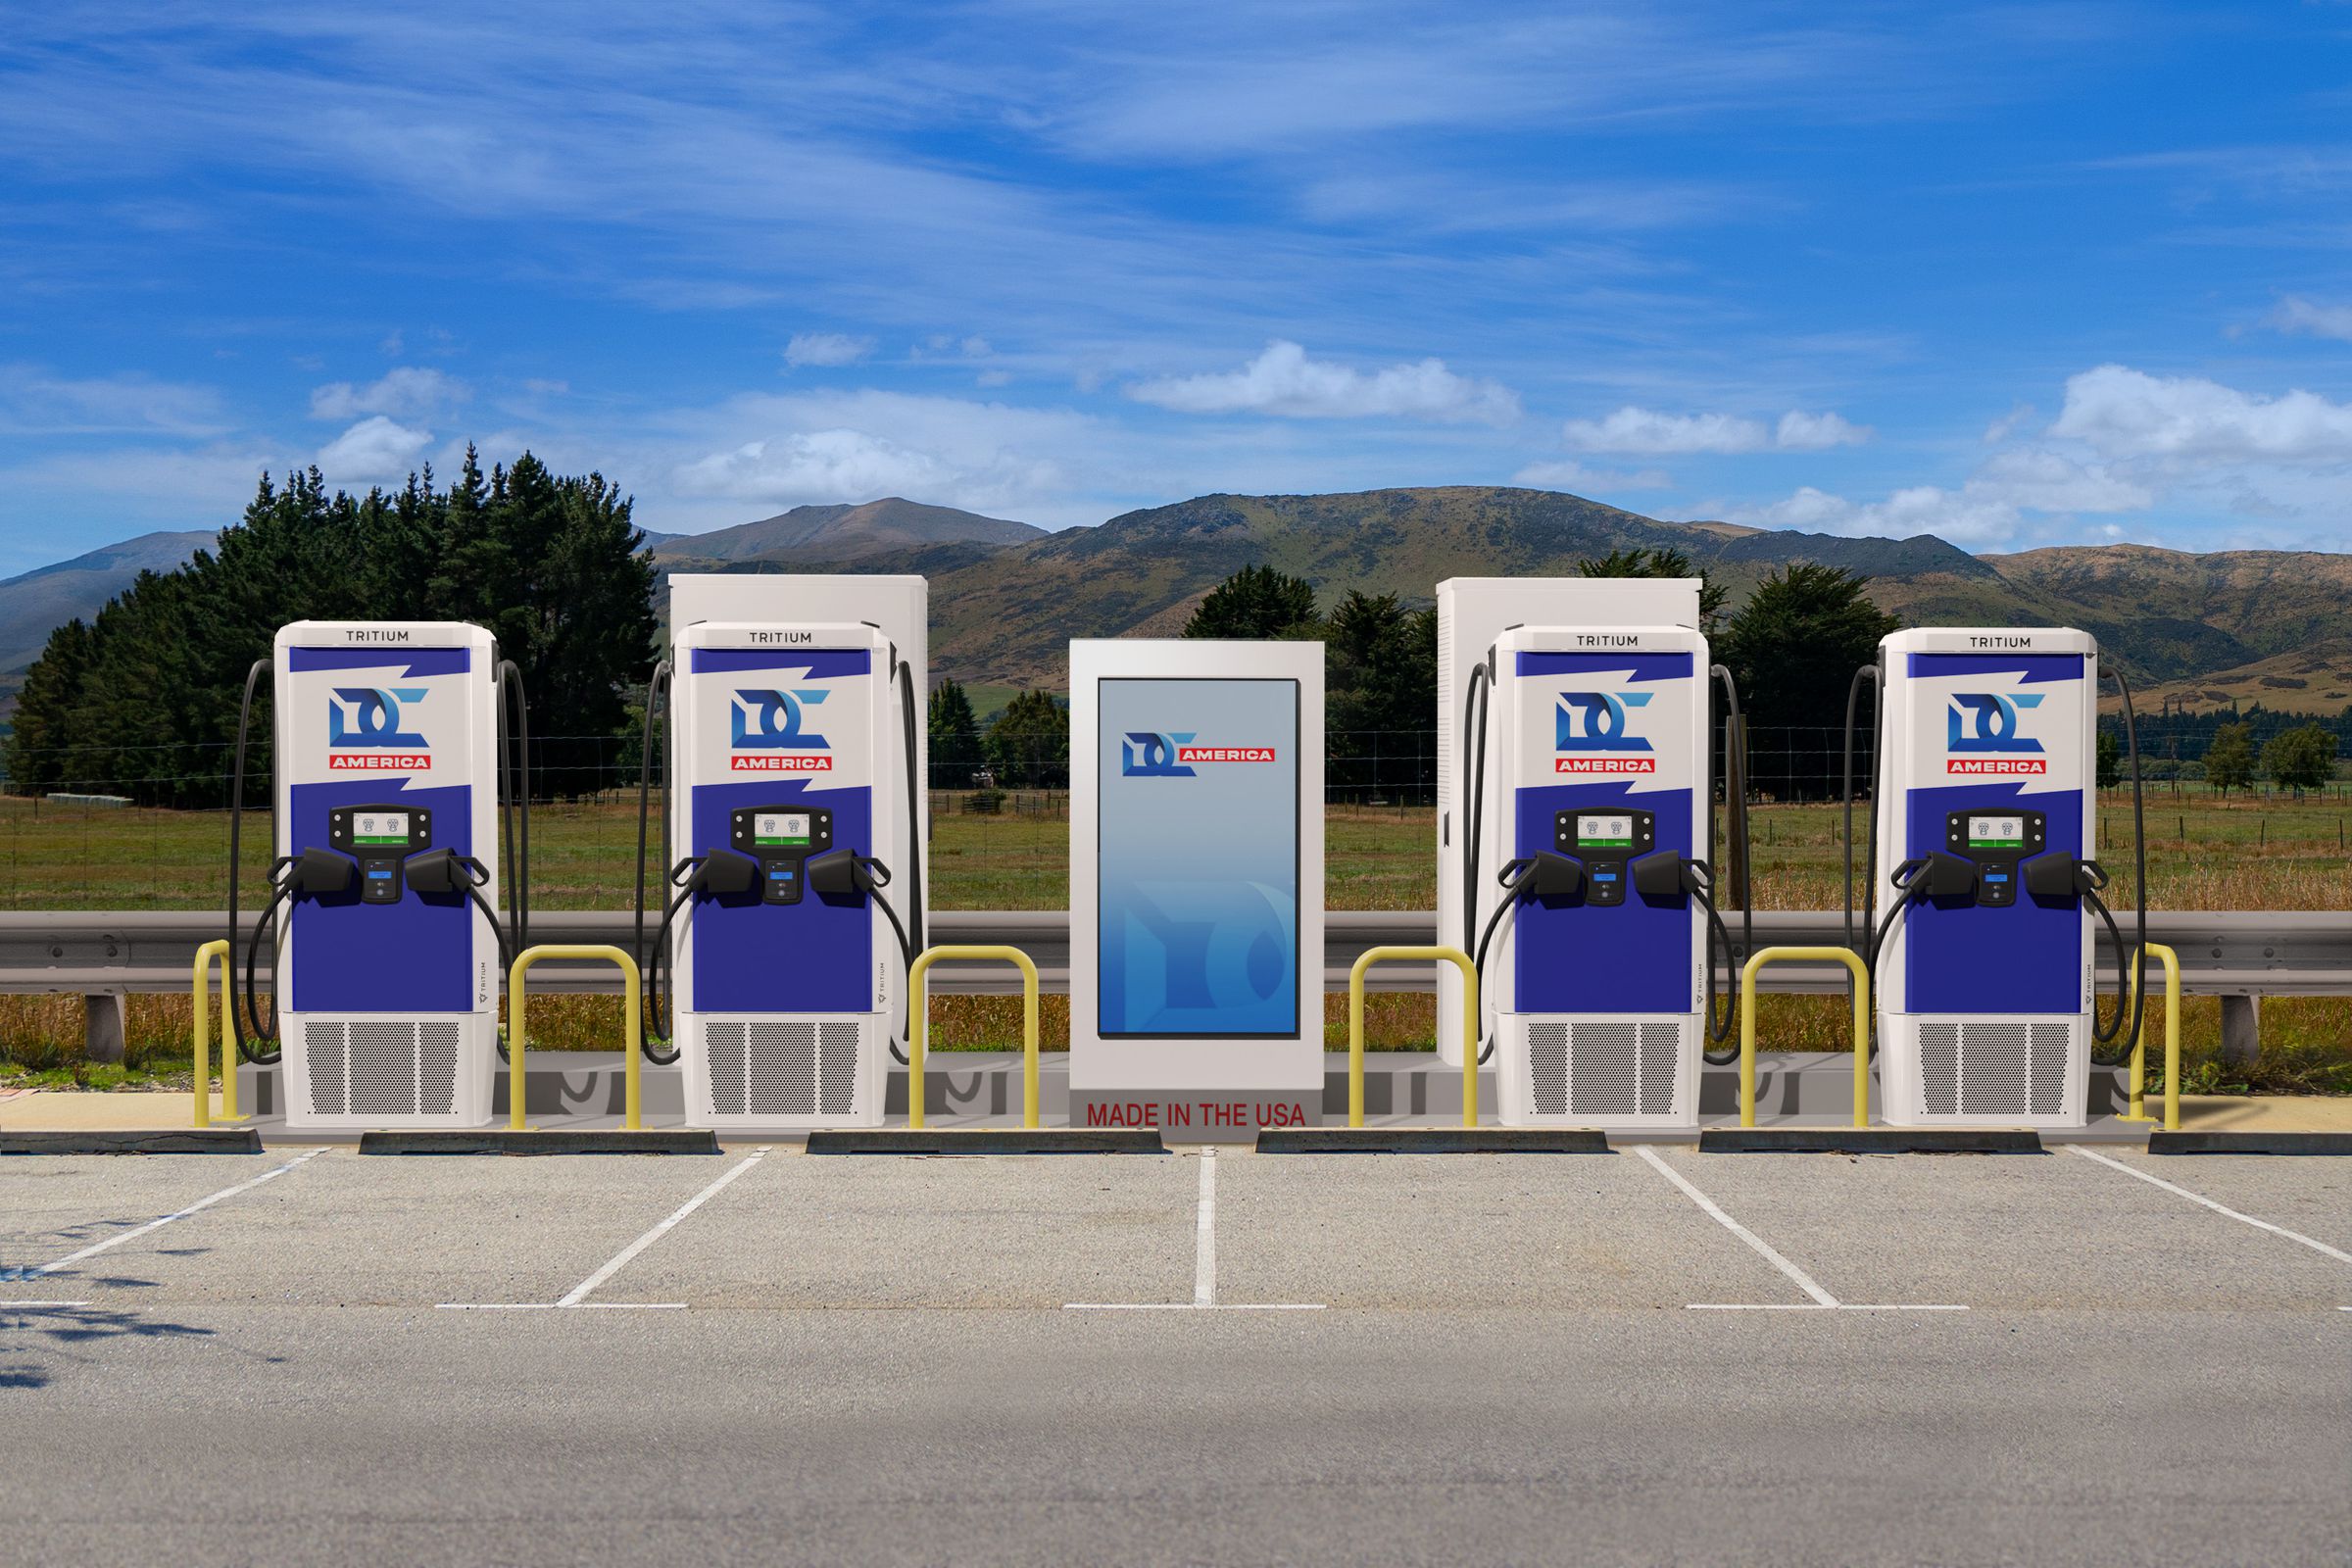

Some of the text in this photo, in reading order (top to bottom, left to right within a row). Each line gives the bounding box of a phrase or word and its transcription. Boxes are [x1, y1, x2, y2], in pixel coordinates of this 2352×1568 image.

[346, 630, 409, 641] TRITIUM
[750, 632, 811, 643] TRITIUM
[1577, 635, 1639, 646] TRITIUM
[1970, 637, 2031, 648] TRITIUM
[1182, 750, 1272, 760] AMERICA
[333, 758, 427, 768] AMERICA
[735, 759, 829, 769] AMERICA
[1559, 760, 1652, 771] AMERICA
[1950, 761, 2043, 772] AMERICA
[1087, 1103, 1305, 1126] MADE IN THE USA
